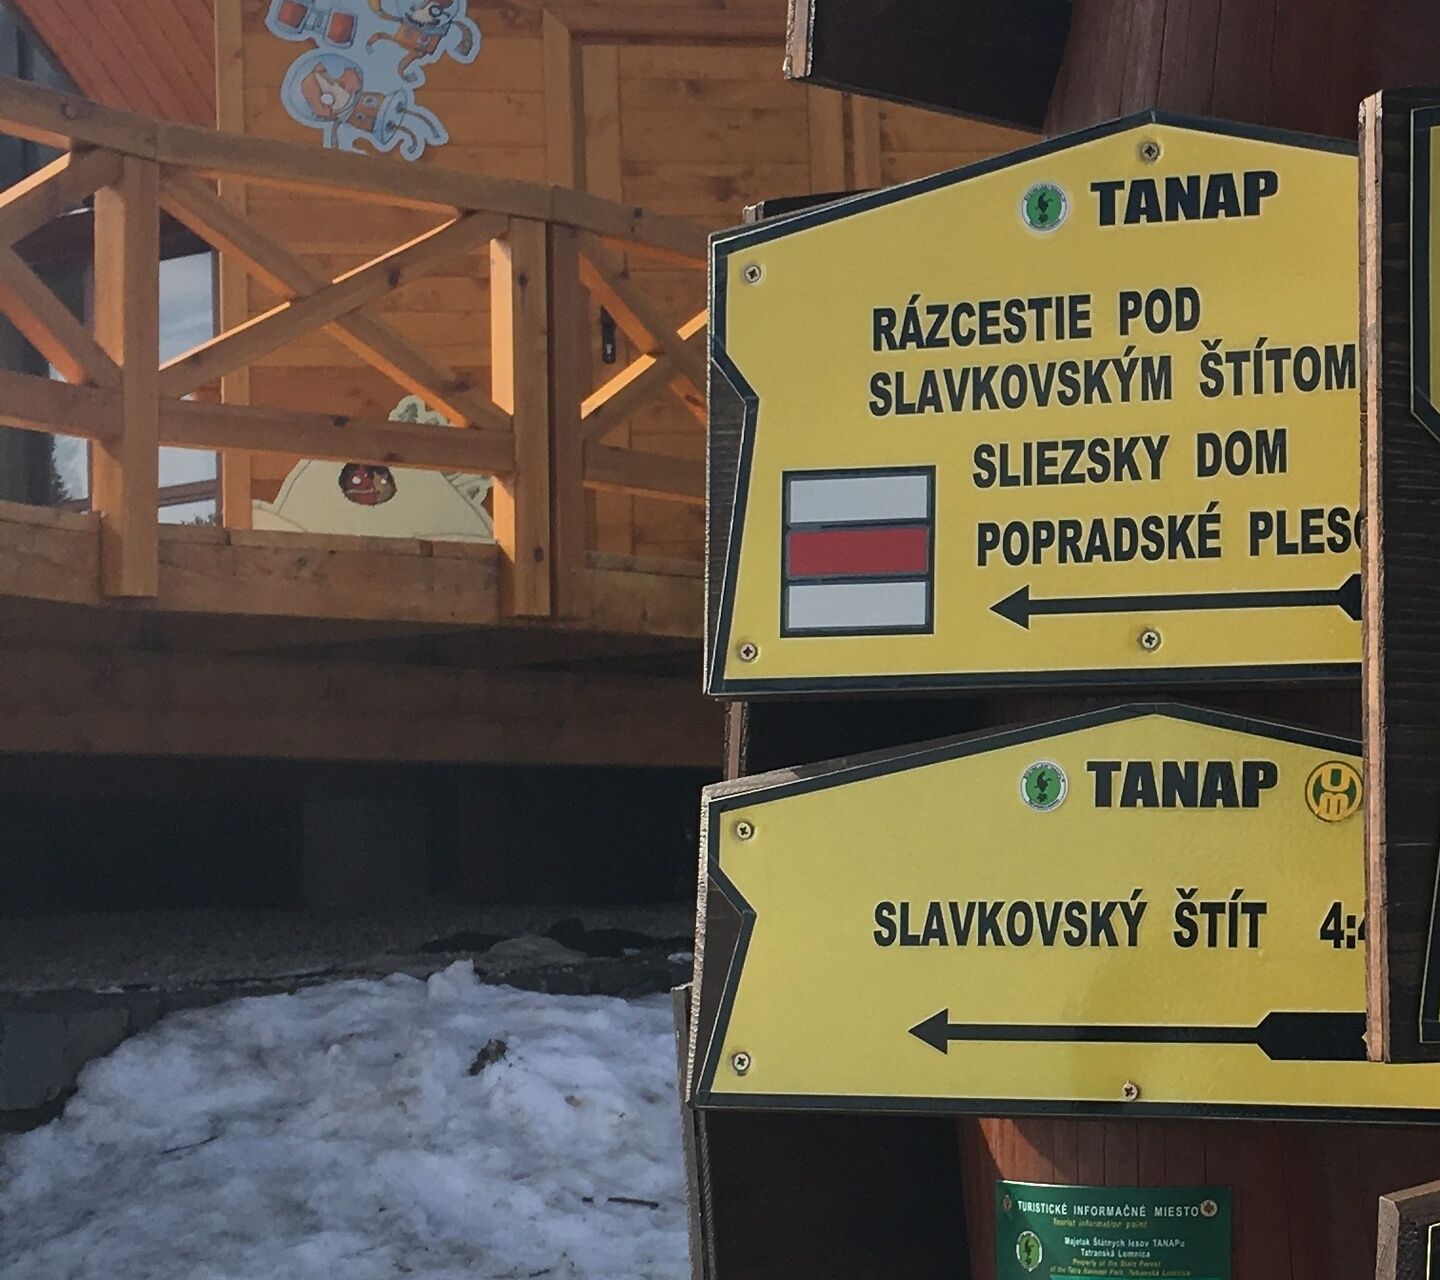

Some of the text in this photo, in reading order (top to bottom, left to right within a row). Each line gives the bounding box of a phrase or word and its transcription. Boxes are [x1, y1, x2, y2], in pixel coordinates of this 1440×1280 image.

[1091, 171, 1278, 226] TANAP
[873, 287, 1200, 351] RÁZCESTIE POD
[869, 337, 1356, 416] SLAVKOVSKÝM ŠTÍTOM
[973, 429, 1286, 488] SLIEZSKY DOM
[978, 501, 1221, 566] POPRADSKÉ
[1087, 761, 1277, 808] TANAP
[874, 889, 1148, 947] SLAVKOVSKÝ
[1174, 888, 1267, 948] ŠTÍT
[1017, 1200, 1199, 1217] TURISTICKÉ INFORMAČNÉ MIESTO
